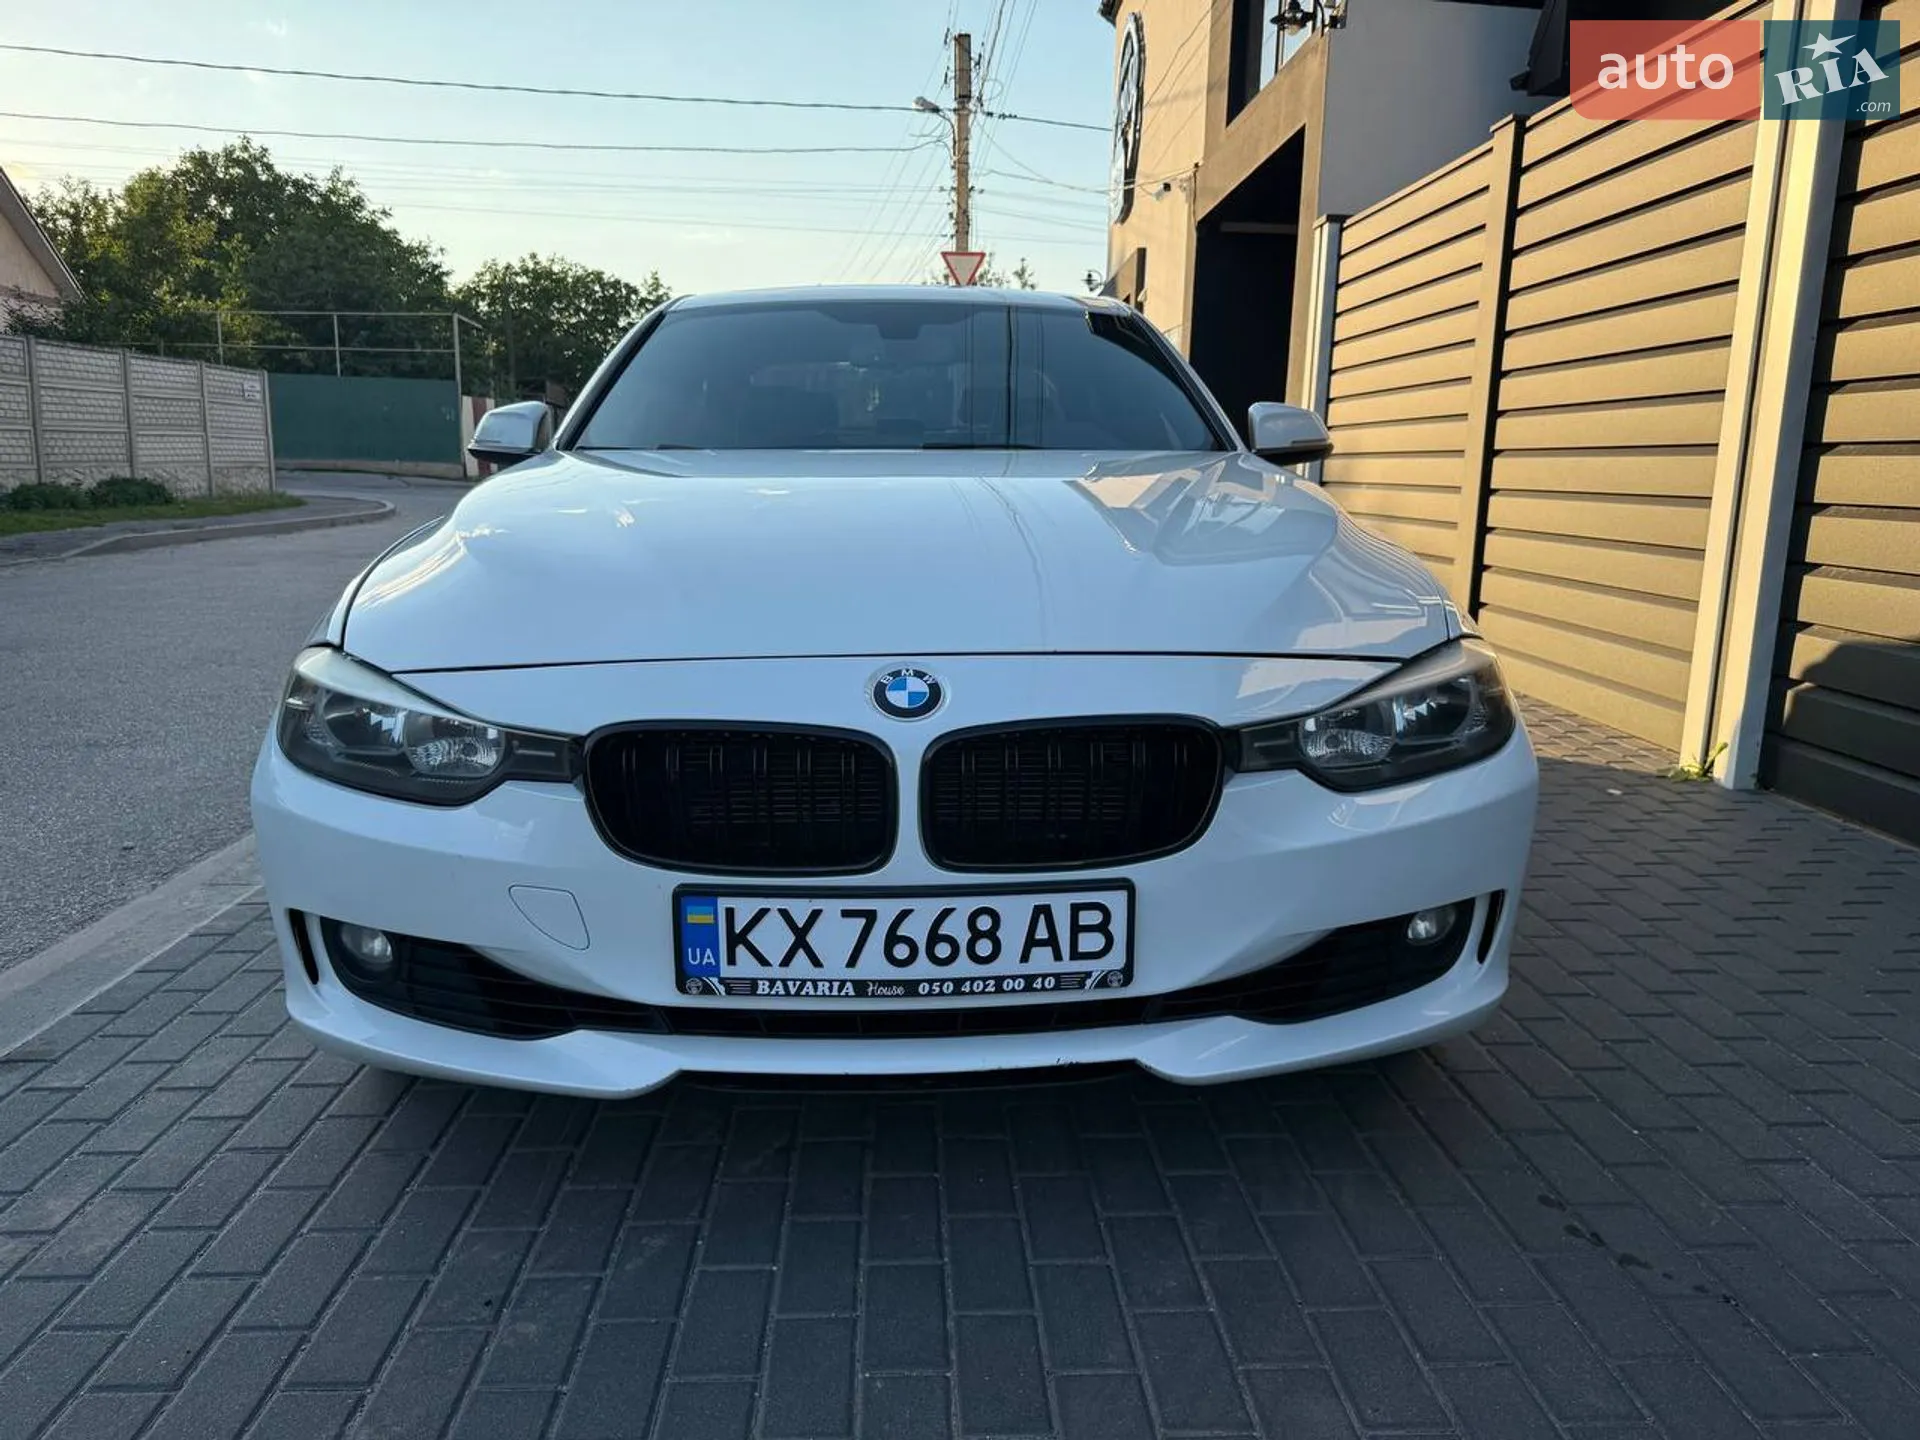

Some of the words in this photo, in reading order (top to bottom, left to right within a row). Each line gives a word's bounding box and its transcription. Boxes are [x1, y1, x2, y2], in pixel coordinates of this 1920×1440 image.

[881, 668, 936, 684] BMW
[725, 906, 825, 969] KX
[840, 905, 1002, 969] 7668
[1019, 902, 1115, 964] AB
[688, 947, 715, 966] UA
[756, 979, 856, 996] BAVARIA
[866, 980, 906, 996] House
[918, 981, 954, 995] 050
[961, 979, 996, 993] 402
[1002, 977, 1030, 991] 00
[1032, 976, 1055, 989] 40
